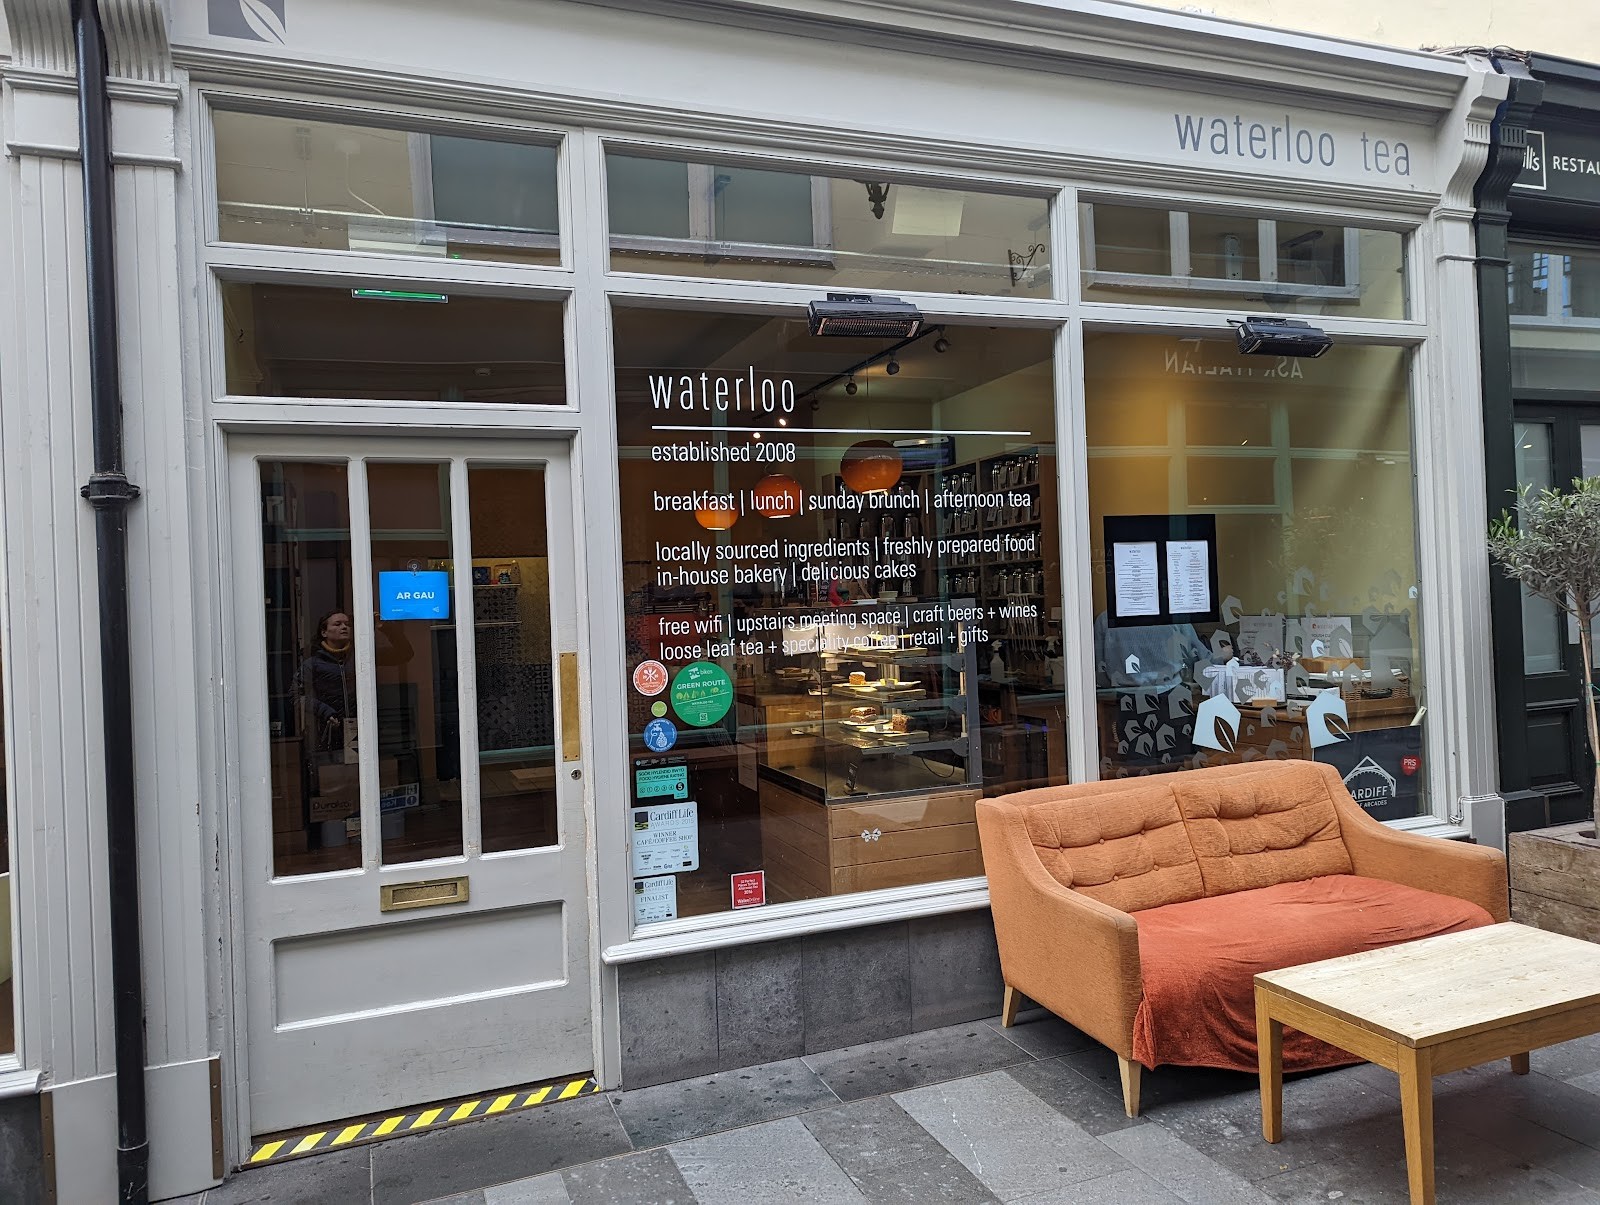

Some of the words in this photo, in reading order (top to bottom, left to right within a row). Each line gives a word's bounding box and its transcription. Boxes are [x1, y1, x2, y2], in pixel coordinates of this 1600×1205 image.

[1175, 114, 1335, 166] waterloo
[1360, 131, 1410, 176] tea
[1522, 145, 1540, 171] ill's
[648, 366, 795, 412] waterloo
[652, 440, 750, 462] established
[756, 442, 796, 462] 2008
[653, 490, 736, 511] breakfast
[750, 490, 794, 511] lunch
[808, 489, 864, 514] sunday
[869, 489, 920, 509] brunch
[934, 489, 1004, 508] afternoon
[1008, 490, 1032, 507] tea
[656, 540, 710, 565] locally
[715, 539, 779, 560] sourced
[783, 538, 870, 562] ingredients
[883, 536, 934, 558] freshly
[938, 534, 1000, 558] prepared
[1004, 533, 1036, 552] food
[656, 566, 729, 586] in-house
[734, 563, 787, 586] bakery
[801, 561, 870, 581] delicious
[874, 560, 917, 578] cakes
[396, 592, 411, 600] AR
[413, 591, 435, 599] GAU
[658, 617, 690, 636] free
[694, 614, 723, 634] wifi
[736, 612, 795, 636] upstairs
[800, 609, 857, 630] meeting
[861, 610, 901, 628] space
[912, 604, 944, 623] craft
[949, 604, 984, 622] beers
[999, 602, 1038, 618] wines
[660, 642, 701, 661] loose
[706, 638, 736, 658] leaf
[740, 640, 764, 656] tea
[782, 632, 849, 657] speciality
[852, 631, 897, 648] coffee
[909, 628, 944, 646] retail
[960, 626, 989, 647] gifts
[1403, 758, 1417, 767] PRS
[1351, 785, 1388, 800] ARDIFF
[650, 809, 677, 821] Cardiff
[679, 808, 694, 818] Life
[651, 820, 679, 828] AWARDS
[640, 894, 668, 902] FINALIST
